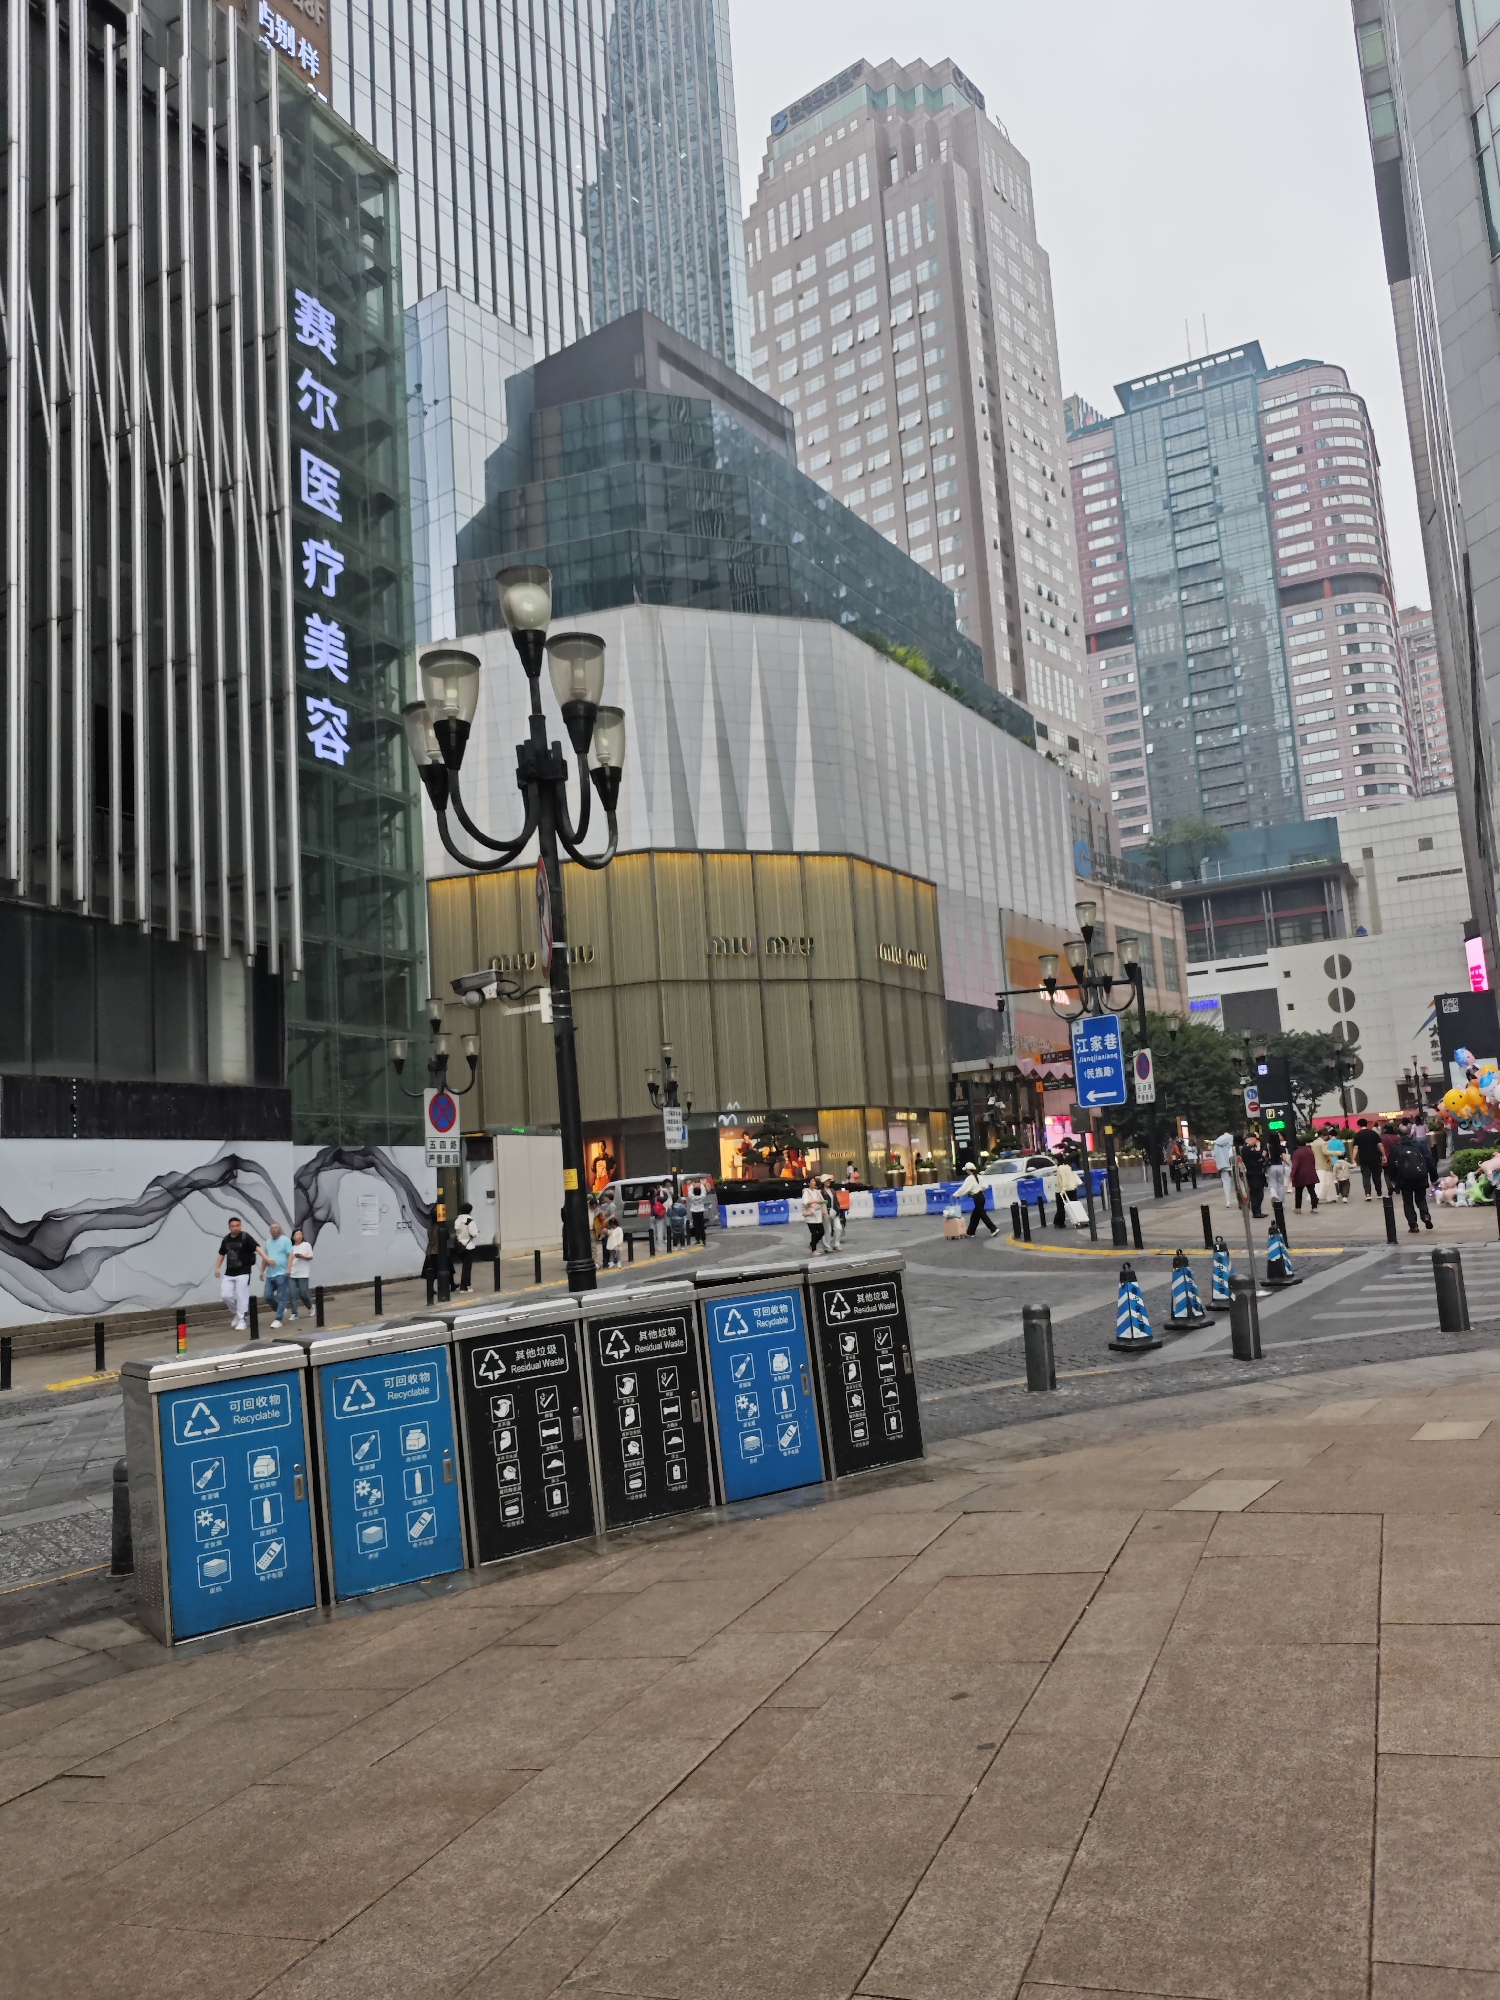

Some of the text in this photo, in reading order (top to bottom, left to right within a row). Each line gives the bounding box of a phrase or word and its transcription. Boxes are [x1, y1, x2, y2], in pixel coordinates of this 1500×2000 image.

[293, 286, 352, 767] 赛尔医疗美容
[1075, 1032, 1118, 1054] 江家巷
[429, 1140, 457, 1150] 五四路
[856, 1290, 890, 1304] 其他垃圾
[752, 1303, 789, 1318] 可回收物
[853, 1300, 896, 1315] Residual Waste
[756, 1315, 789, 1329] Recyclable
[638, 1326, 677, 1342] 其他垃圾
[514, 1344, 558, 1361] 其他垃圾
[634, 1338, 684, 1354] Residual Waste
[510, 1356, 565, 1374] Residual Waste
[383, 1371, 431, 1389] 可回收物
[387, 1386, 430, 1401] Recyclable
[228, 1393, 281, 1412] 可回收物
[232, 1408, 281, 1425] Recyclable
